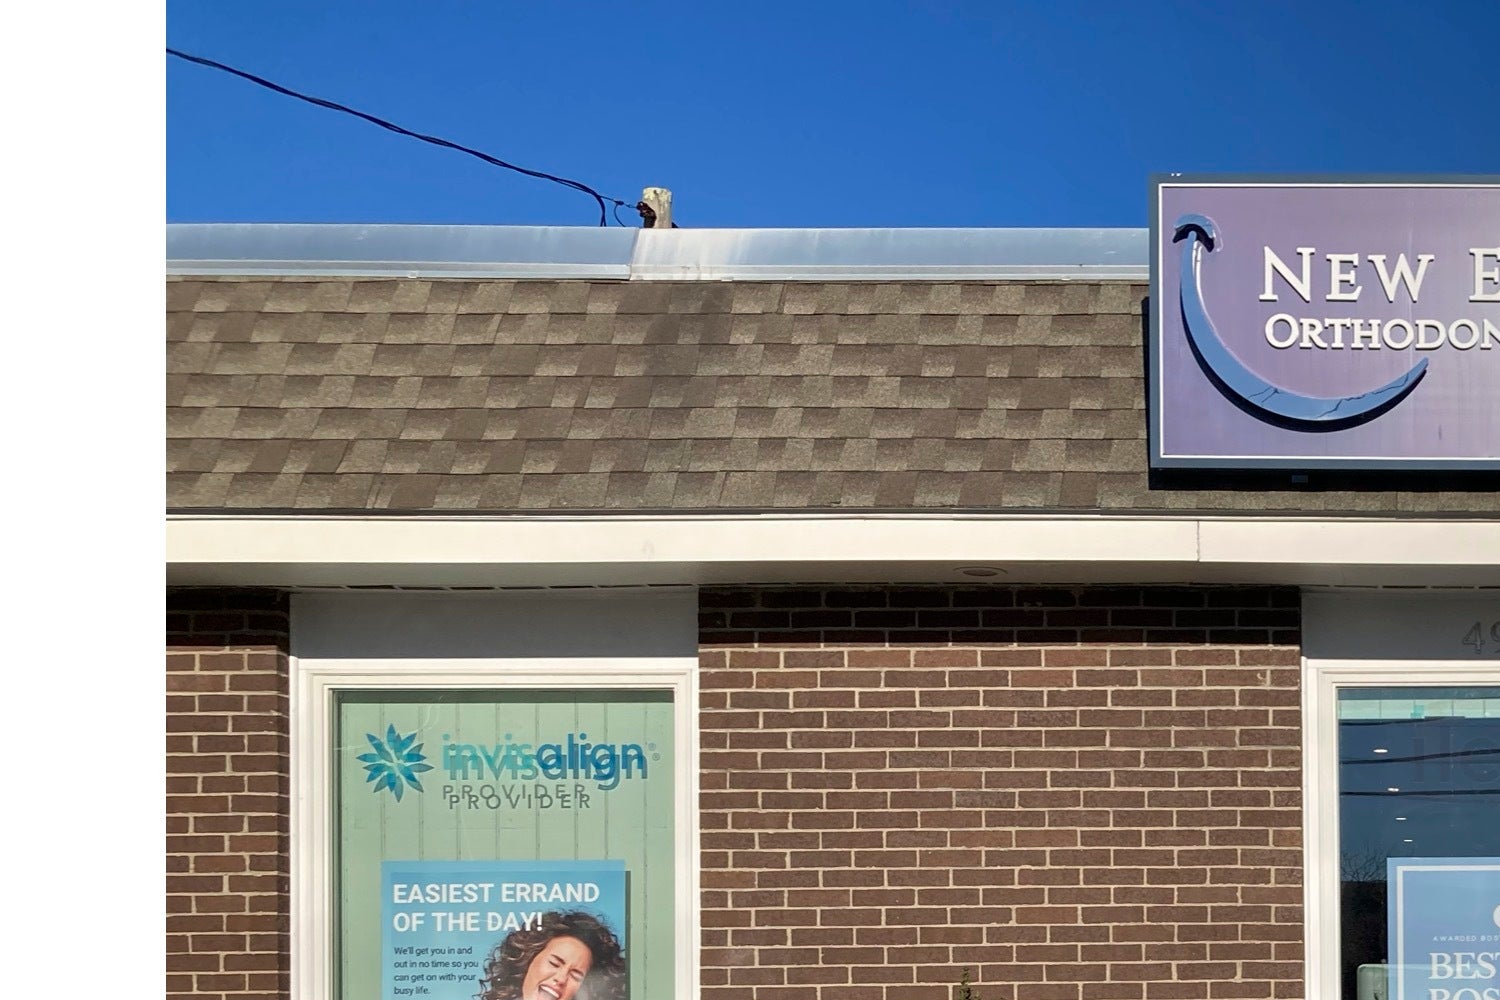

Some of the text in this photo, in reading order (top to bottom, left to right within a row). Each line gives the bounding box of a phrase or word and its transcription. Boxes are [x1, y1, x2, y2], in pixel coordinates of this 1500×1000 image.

[1259, 246, 1435, 304] NEW
[442, 733, 646, 788] invisalign
[442, 784, 590, 806] PROVIDER
[393, 883, 600, 903] EASIEST ERRAND
[393, 911, 543, 932] OF THE DAY!
[394, 946, 473, 956] We'll get you in and
[394, 961, 408, 969] out
[409, 960, 417, 968] in
[431, 960, 450, 968] time
[463, 961, 479, 969] you
[410, 974, 425, 983] get
[439, 973, 456, 981] with
[457, 974, 476, 982] your
[394, 986, 431, 996] busy life.
